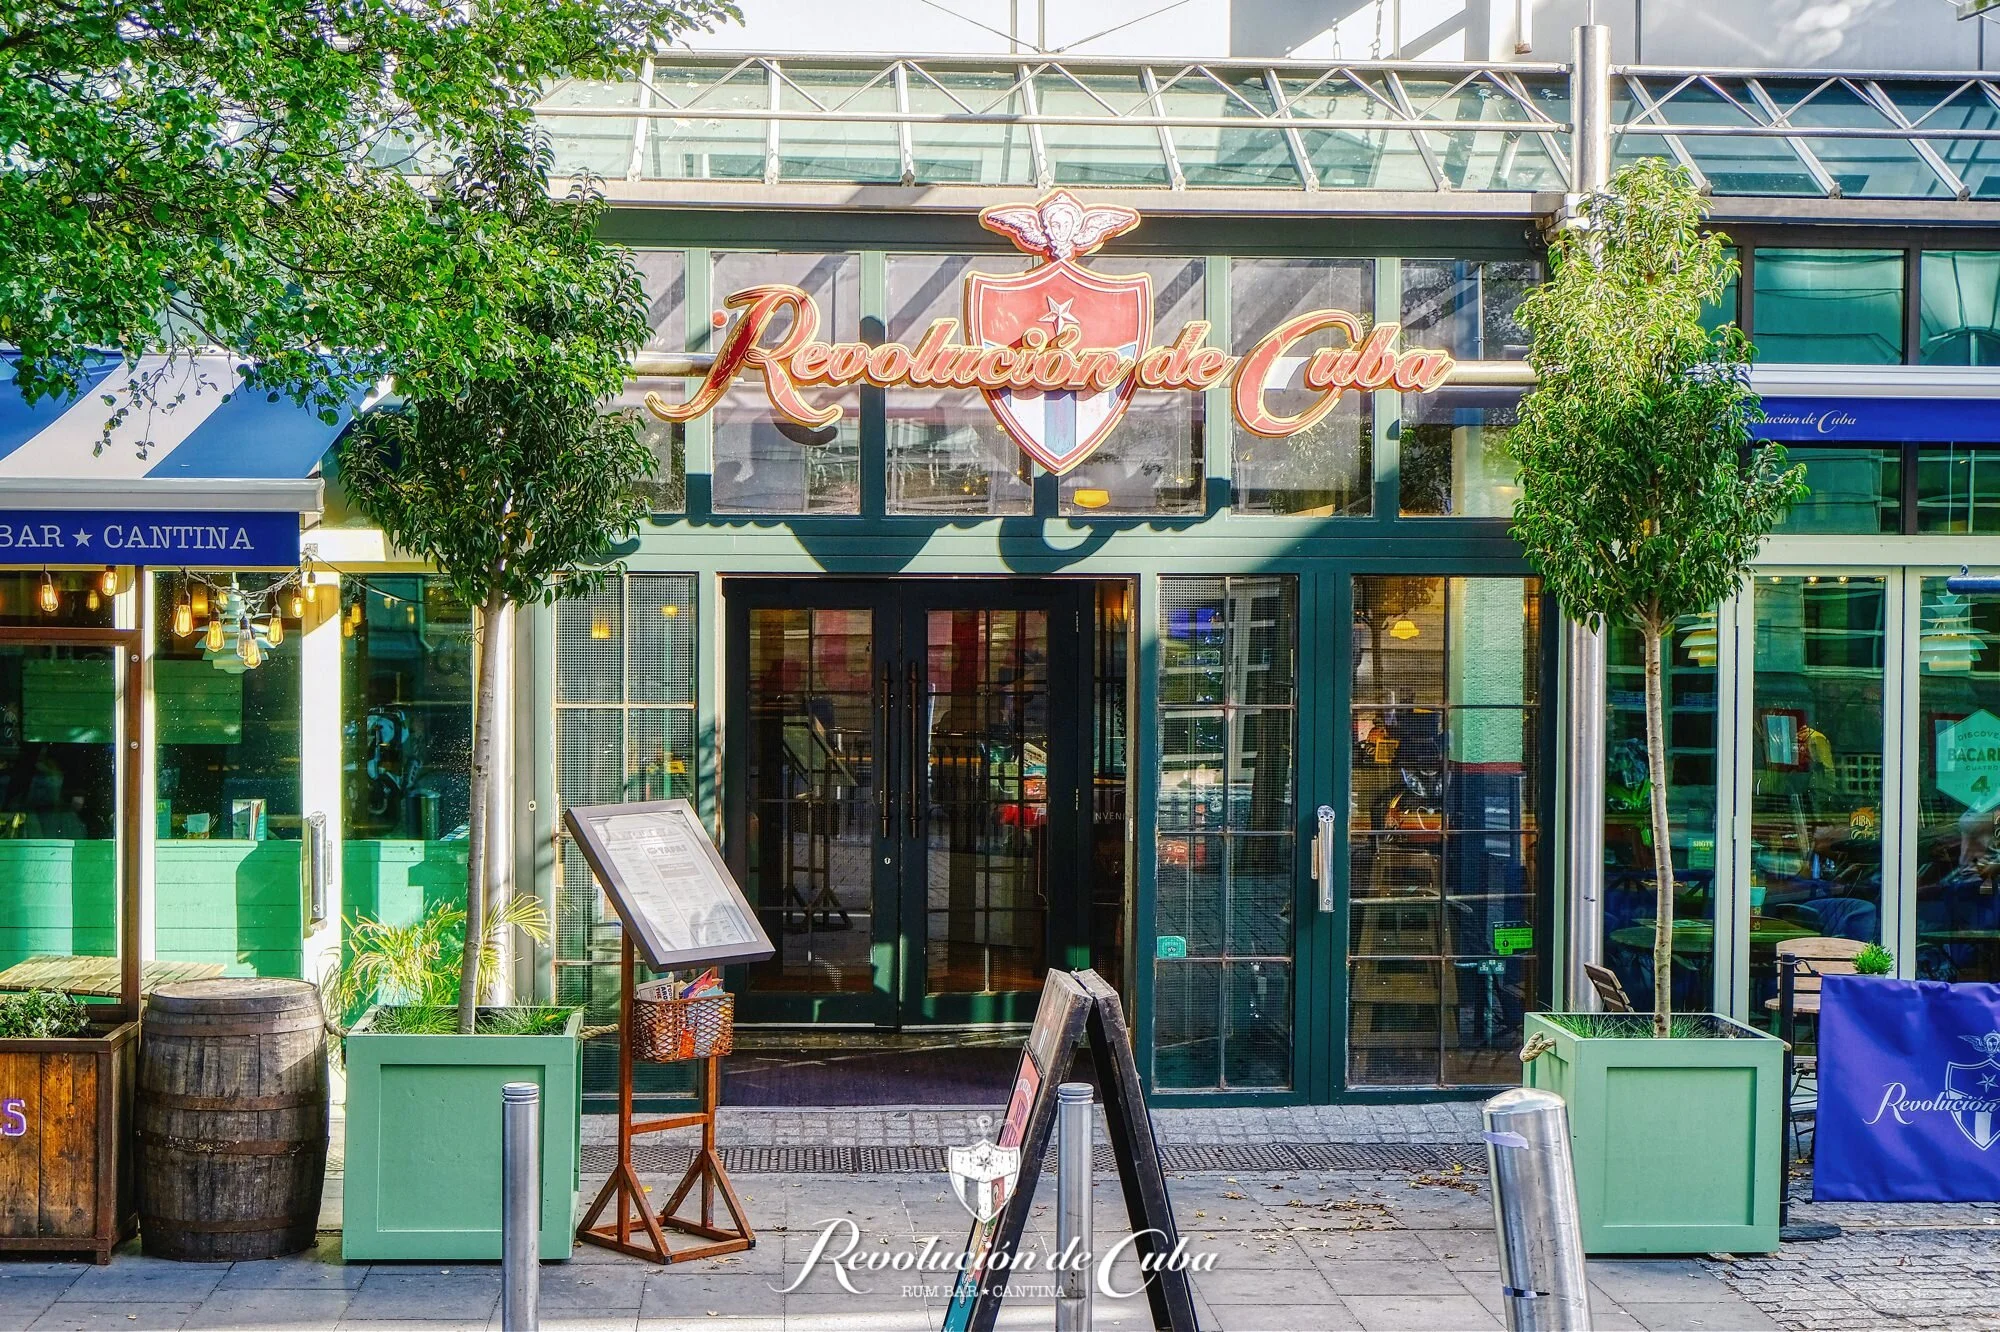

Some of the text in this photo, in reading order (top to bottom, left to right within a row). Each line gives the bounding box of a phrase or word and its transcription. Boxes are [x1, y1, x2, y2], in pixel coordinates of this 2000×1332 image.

[645, 284, 1453, 438] Revolución de Cuba
[1750, 409, 1857, 434] olución de Cuba
[103, 525, 255, 550] CANTINA
[1957, 730, 2000, 742] DISCOVE
[1947, 747, 2000, 762] BACAR
[1970, 775, 1991, 793] 4
[1862, 1082, 2000, 1125] Revolución
[0, 1098, 27, 1136] S
